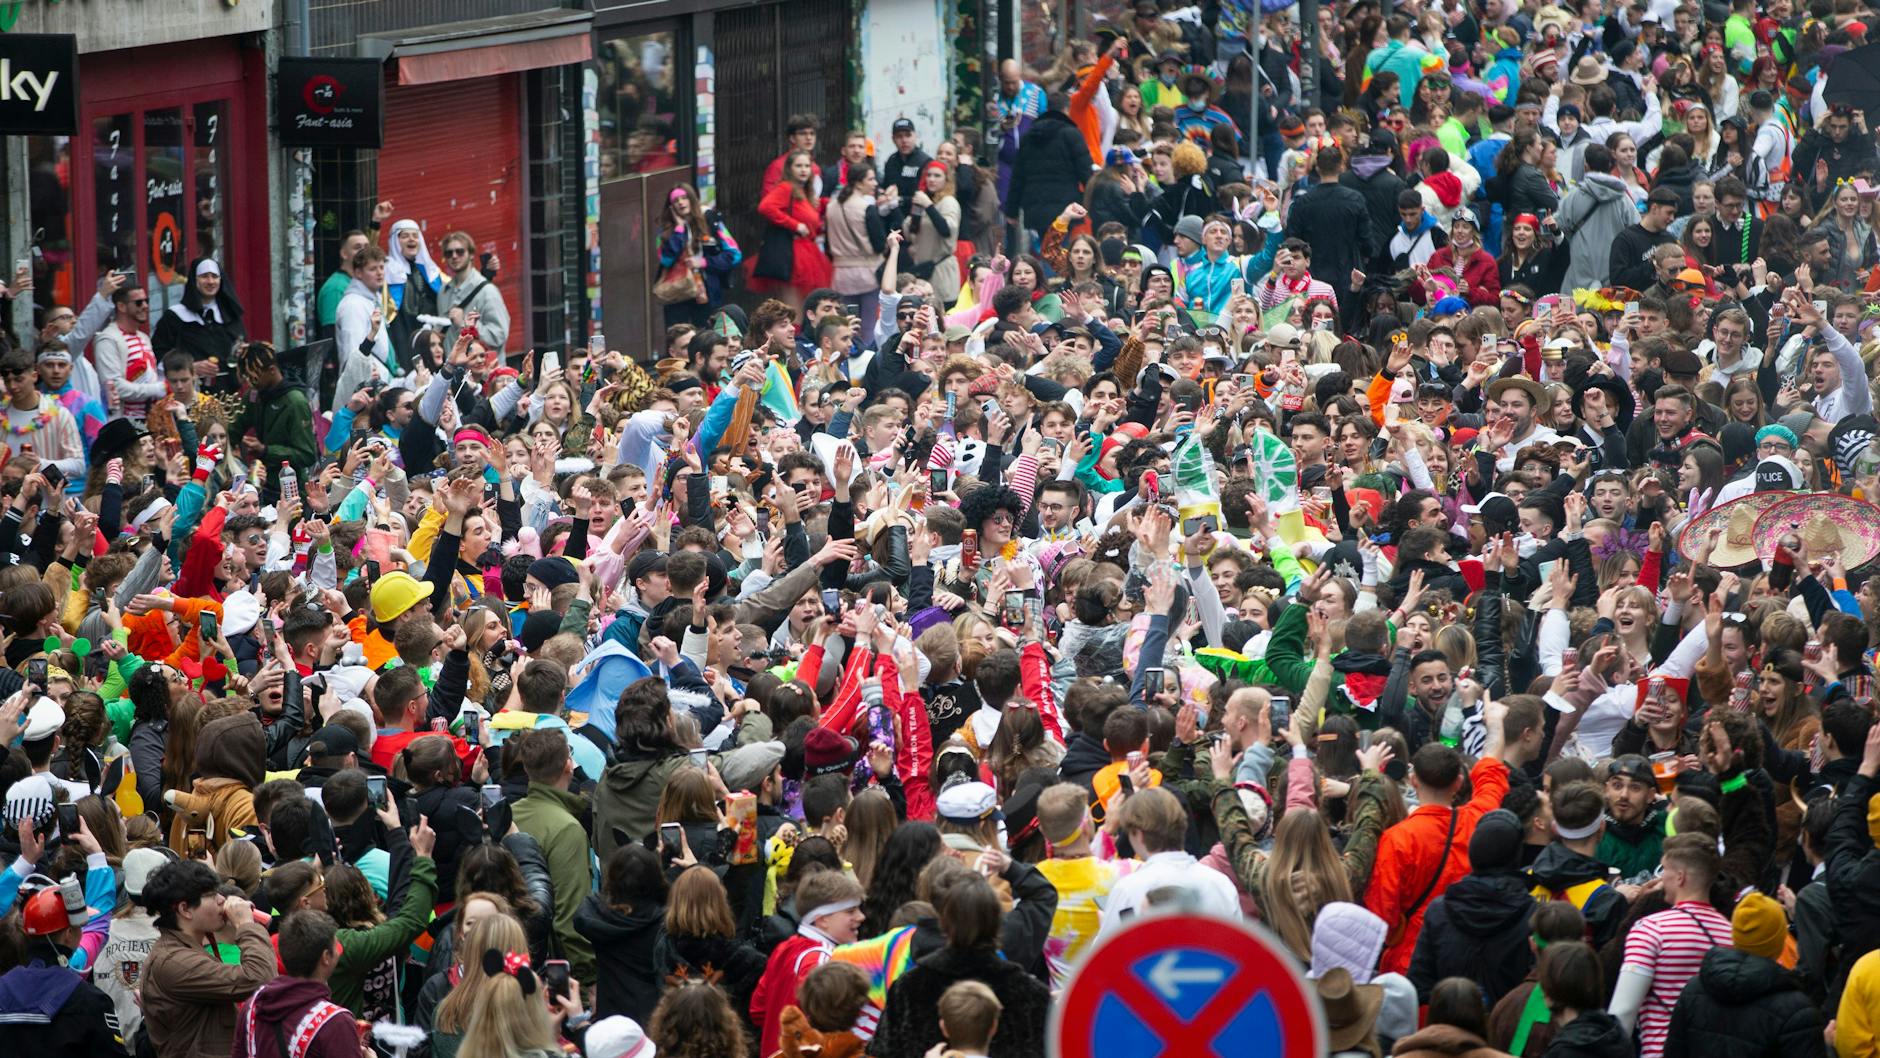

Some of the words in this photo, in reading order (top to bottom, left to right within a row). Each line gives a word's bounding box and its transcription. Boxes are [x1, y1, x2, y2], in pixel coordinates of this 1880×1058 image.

[295, 114, 353, 128] Fant-asia
[909, 706, 917, 732] TEAM
[909, 735, 919, 777] MARATHON
